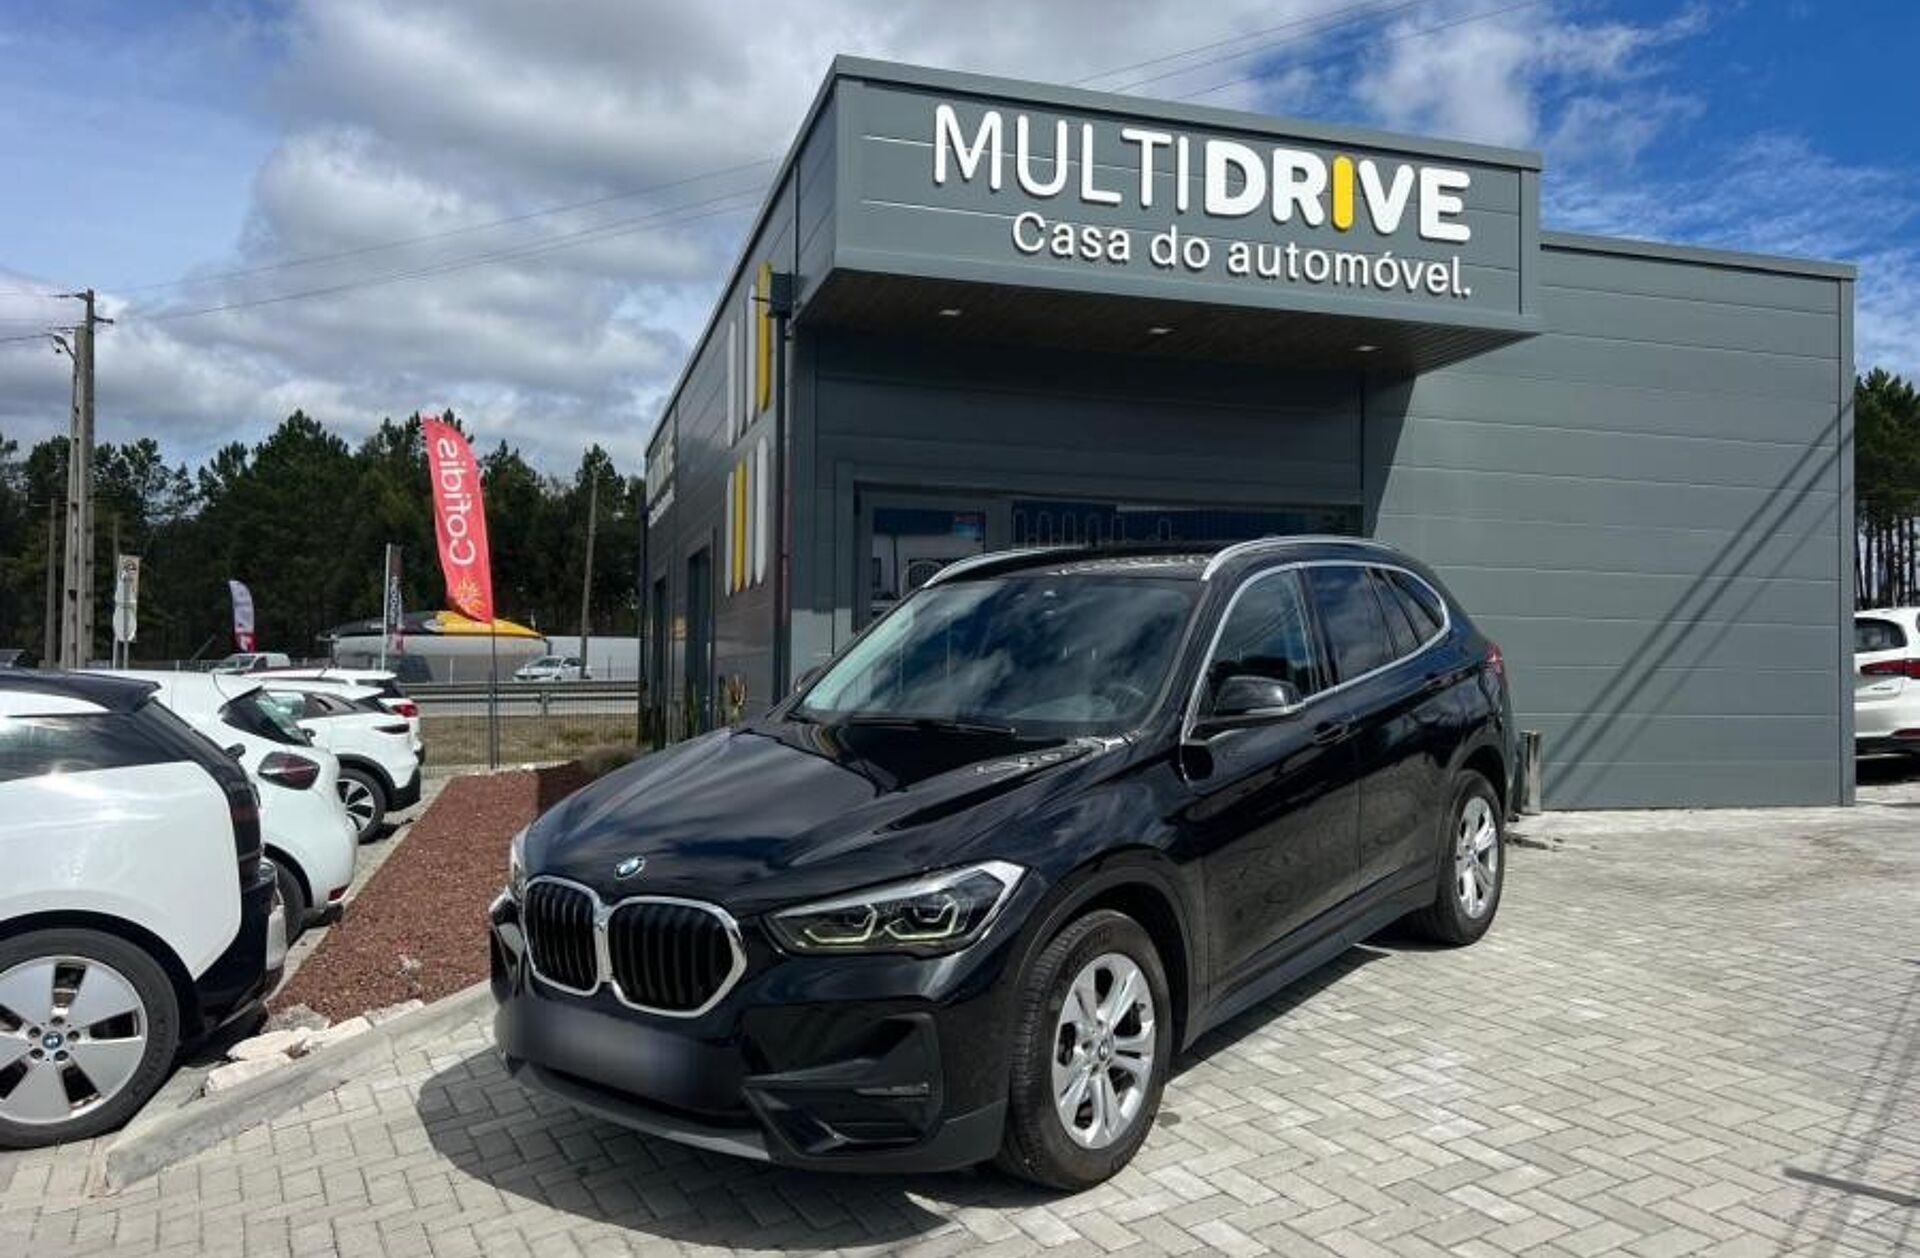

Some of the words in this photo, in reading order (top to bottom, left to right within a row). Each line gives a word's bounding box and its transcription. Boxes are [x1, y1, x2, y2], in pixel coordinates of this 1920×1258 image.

[934, 104, 1471, 242] MULTIDRIVE
[1012, 212, 1131, 262] Casa
[1150, 224, 1211, 269] do
[1227, 242, 1472, 297] automóvel.
